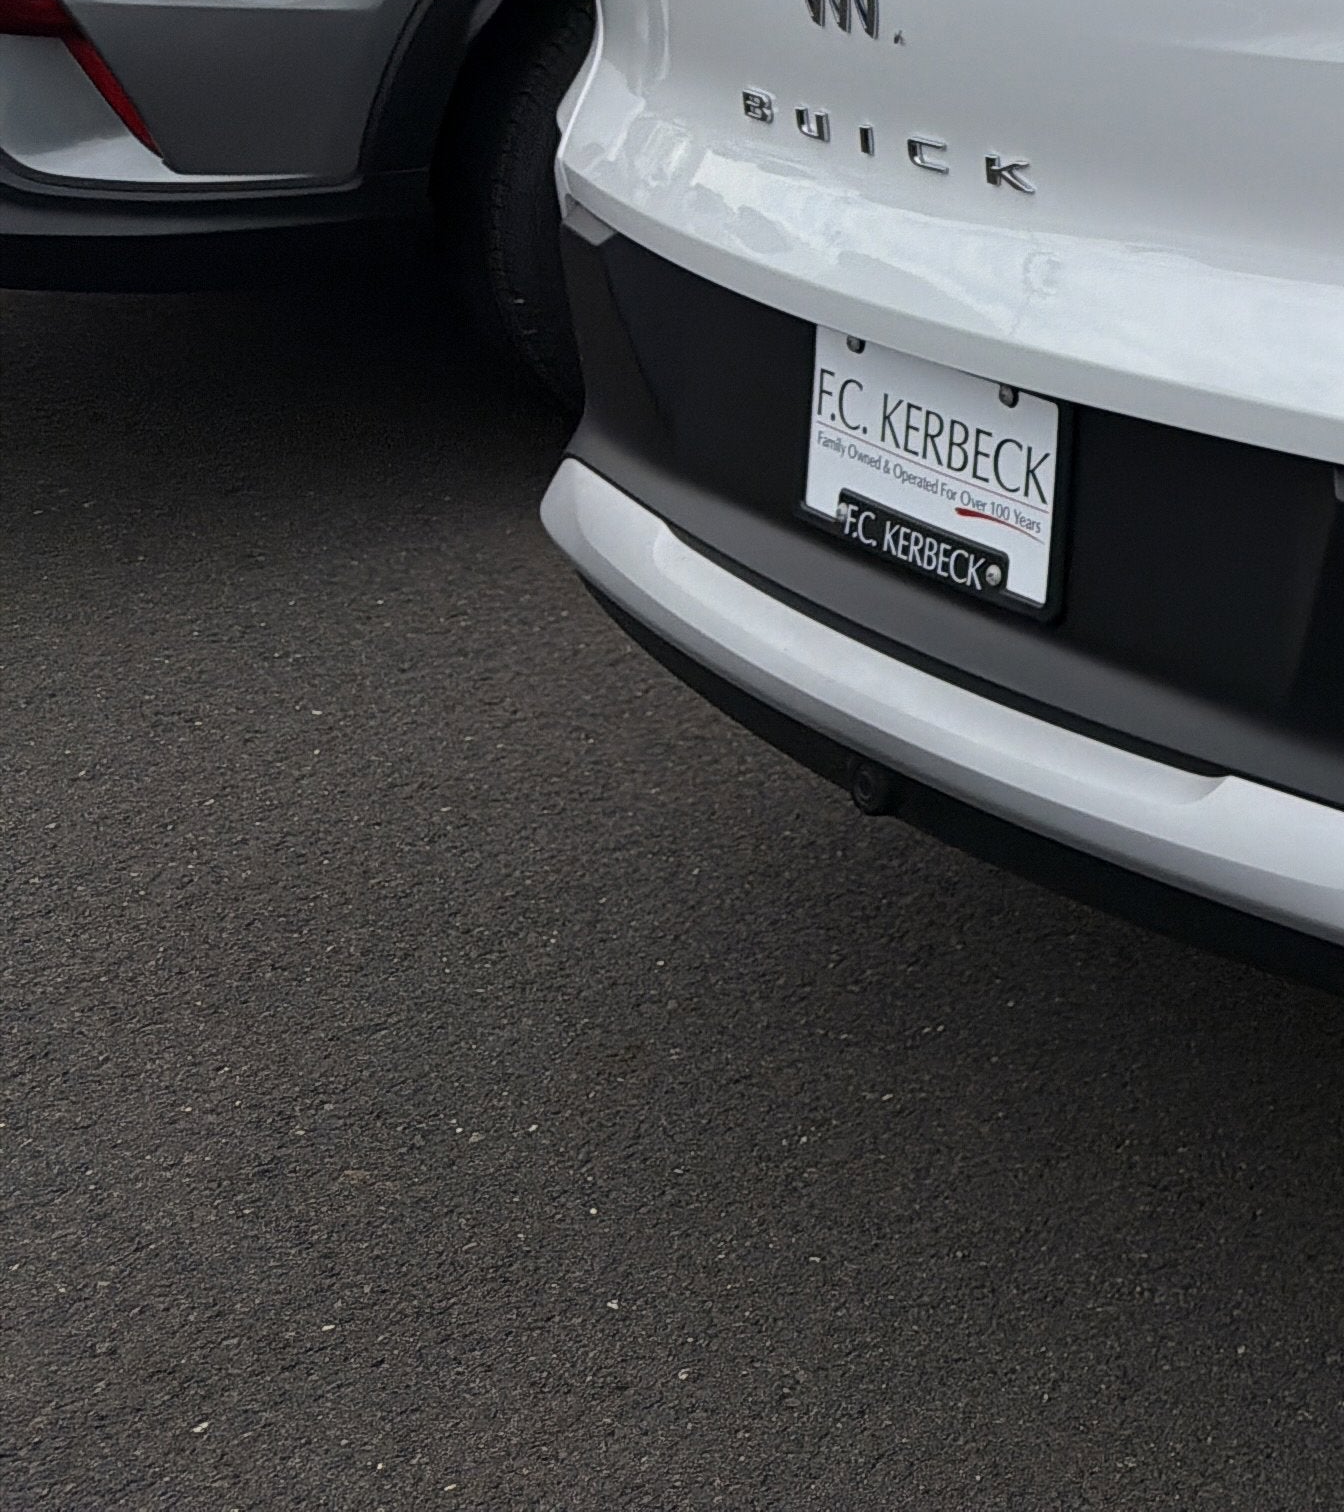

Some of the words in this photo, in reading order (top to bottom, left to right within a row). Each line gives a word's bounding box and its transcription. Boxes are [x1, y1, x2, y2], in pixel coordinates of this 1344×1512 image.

[742, 86, 1036, 194] BUICK
[816, 367, 869, 436] F.C.
[880, 392, 1051, 506] KERBECK
[817, 430, 847, 456] Family
[847, 443, 882, 472] Owned
[883, 459, 892, 474] &
[893, 464, 938, 495] Operated
[940, 483, 957, 502] For
[960, 491, 988, 511] Over
[990, 501, 1011, 521] 100
[1013, 509, 1042, 534] Years
[843, 504, 877, 548] F.C.
[882, 520, 987, 591] KERBECK
